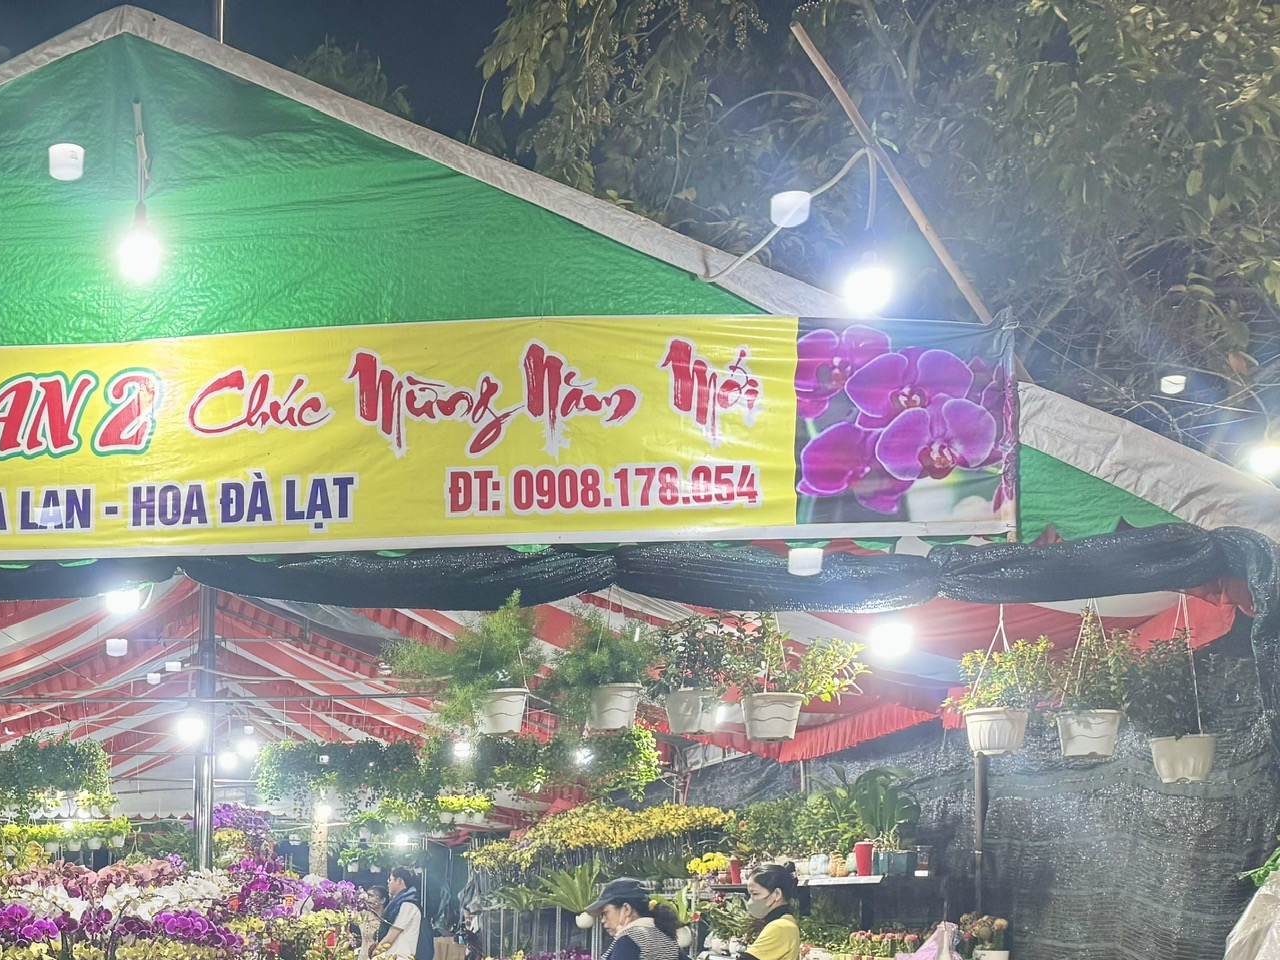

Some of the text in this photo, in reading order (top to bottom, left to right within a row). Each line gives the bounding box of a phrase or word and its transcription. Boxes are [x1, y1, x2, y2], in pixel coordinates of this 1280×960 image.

[96, 371, 158, 453] 2
[189, 339, 759, 453] Chúc Mừng Năm Mới
[19, 488, 92, 531] LAN
[104, 505, 119, 516] -
[131, 483, 208, 528] HOA
[219, 471, 273, 524] ĐÀ
[284, 476, 355, 530] LẠT
[448, 464, 759, 513] ĐT: 0908.178.054
